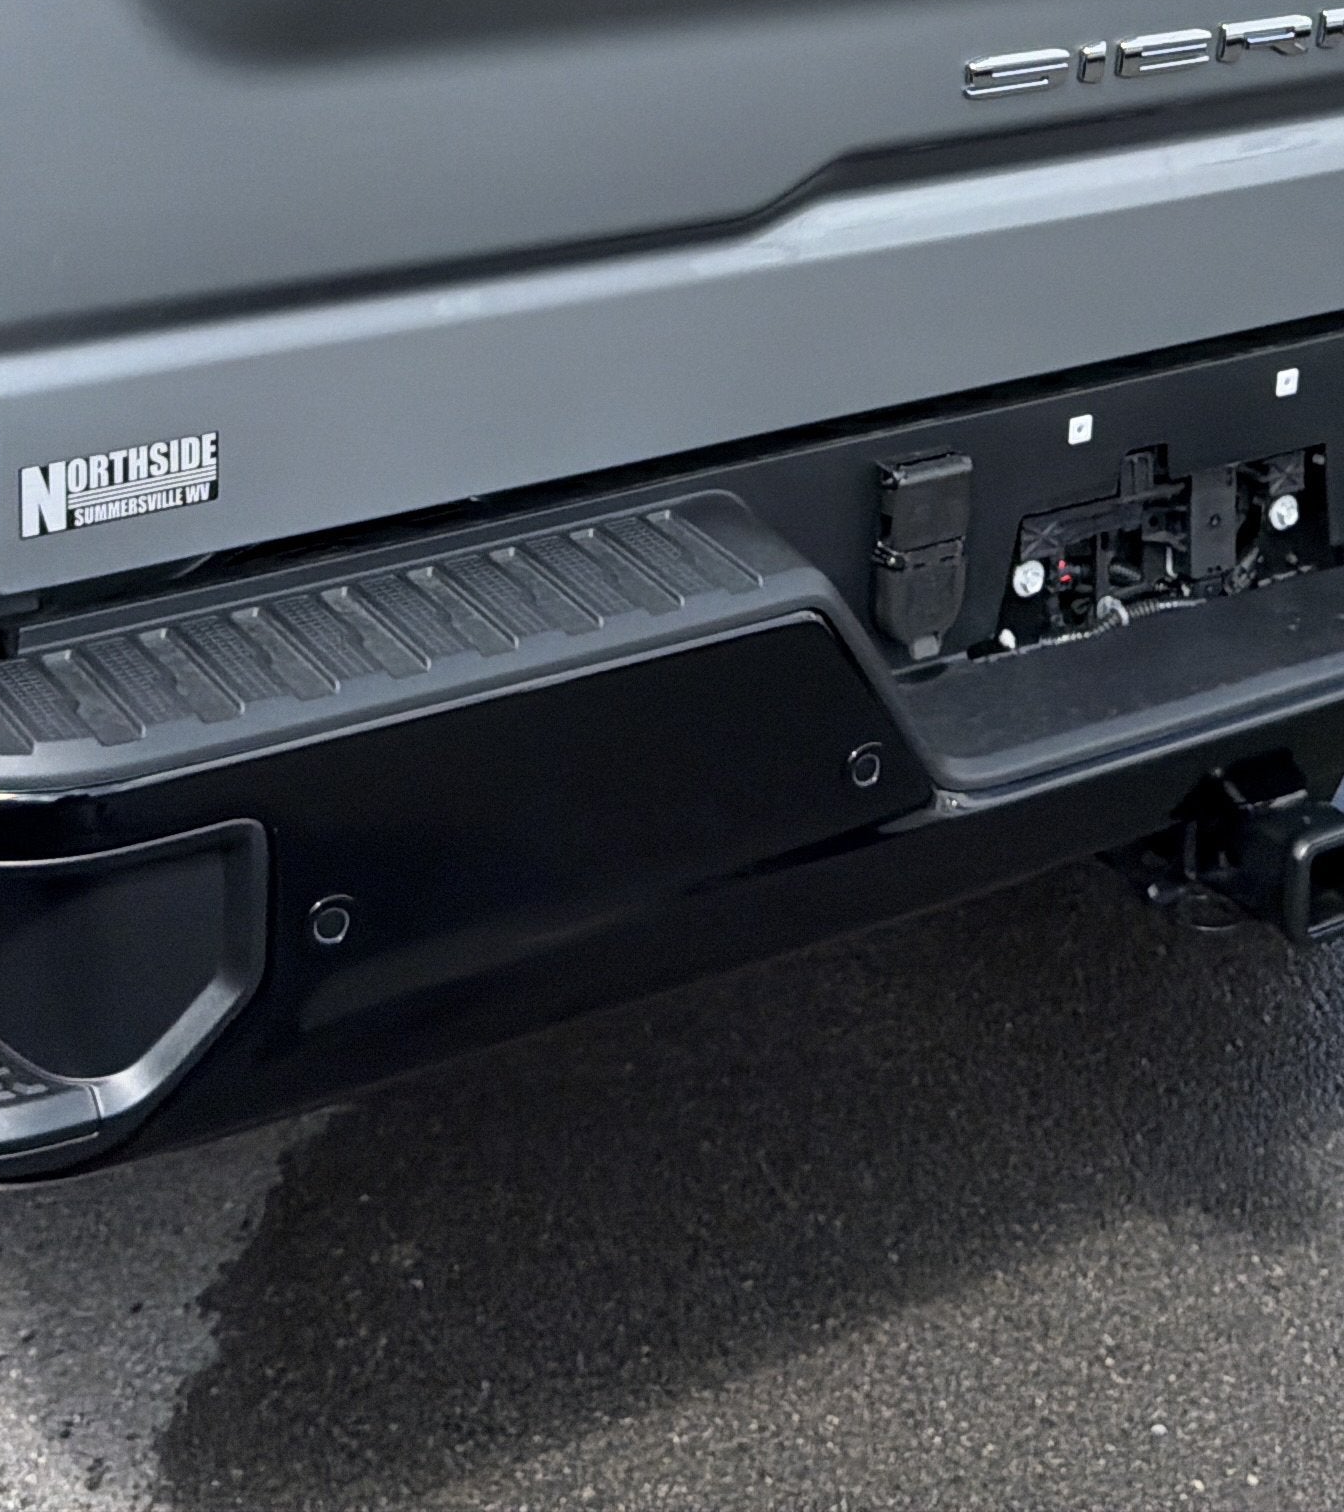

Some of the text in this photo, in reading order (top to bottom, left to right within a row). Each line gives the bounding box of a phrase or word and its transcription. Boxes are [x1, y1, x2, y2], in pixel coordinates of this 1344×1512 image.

[20, 431, 217, 538] NORTHSIDE
[73, 482, 211, 528] SUMMERSVILLE WV
